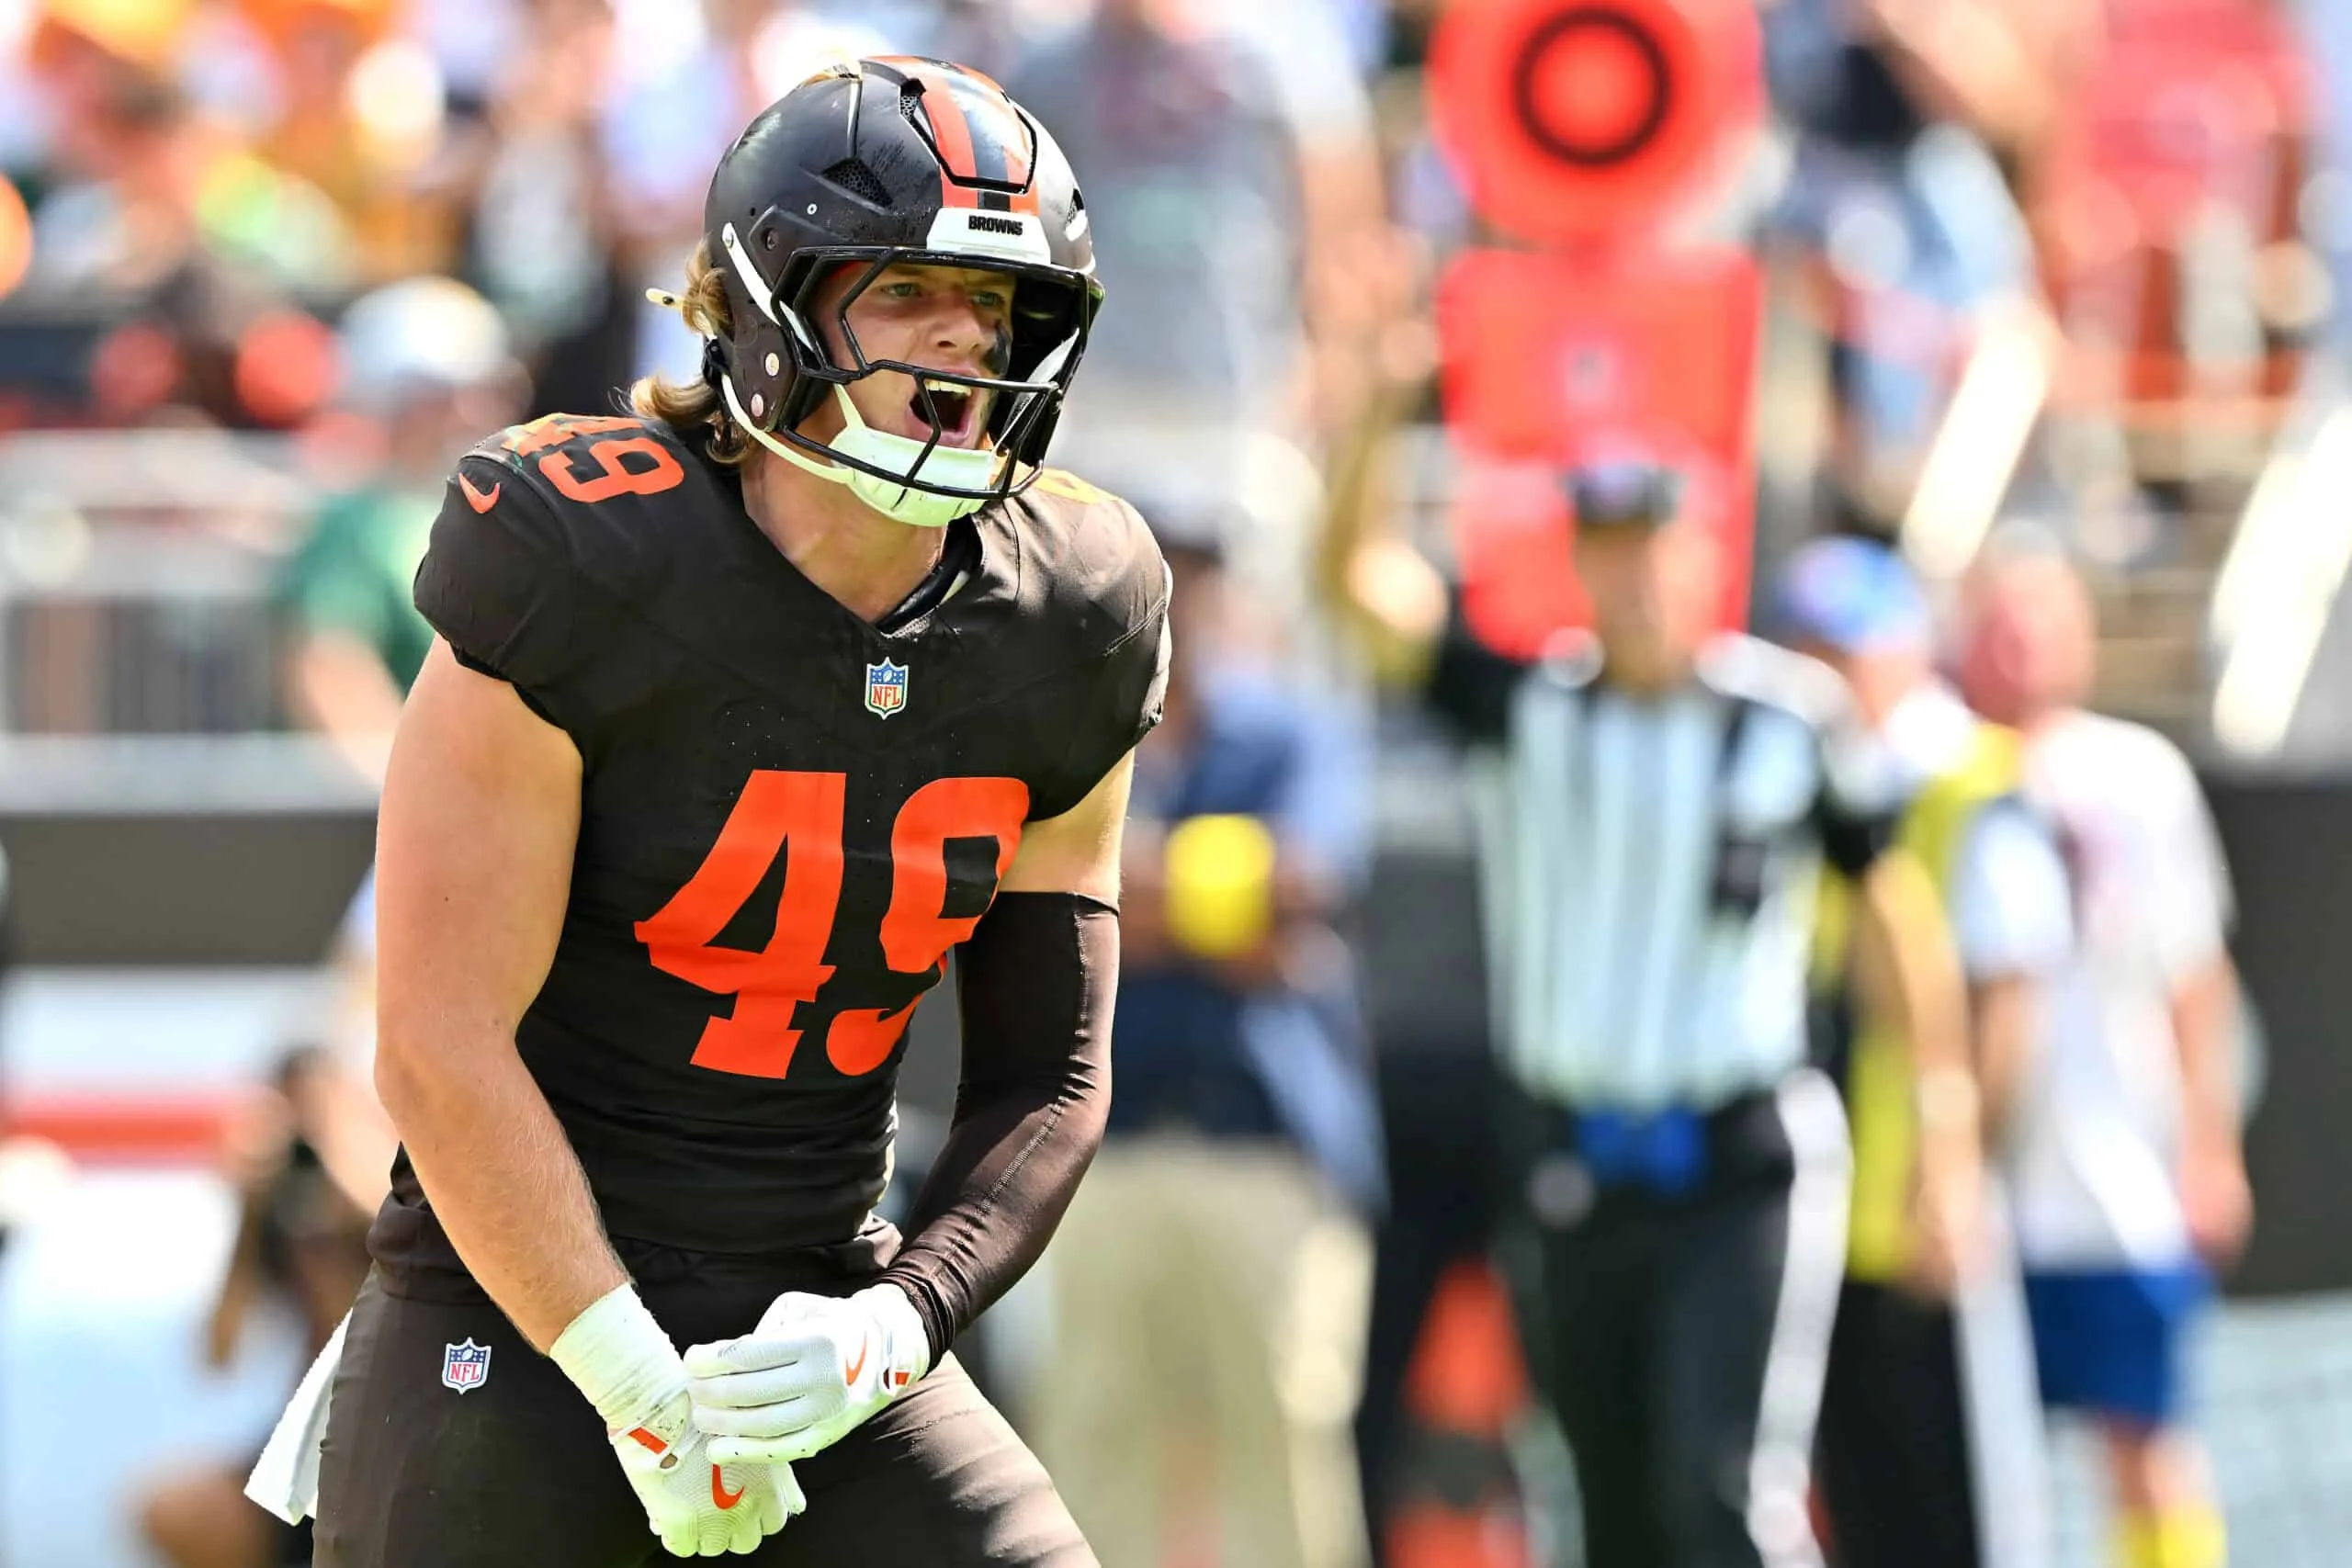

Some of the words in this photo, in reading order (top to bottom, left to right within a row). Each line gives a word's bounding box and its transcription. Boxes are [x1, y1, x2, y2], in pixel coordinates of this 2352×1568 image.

[968, 215, 1023, 236] BROWNS
[873, 686, 900, 707] NFL
[634, 769, 1030, 1080] 49
[449, 1363, 480, 1382] NFL
